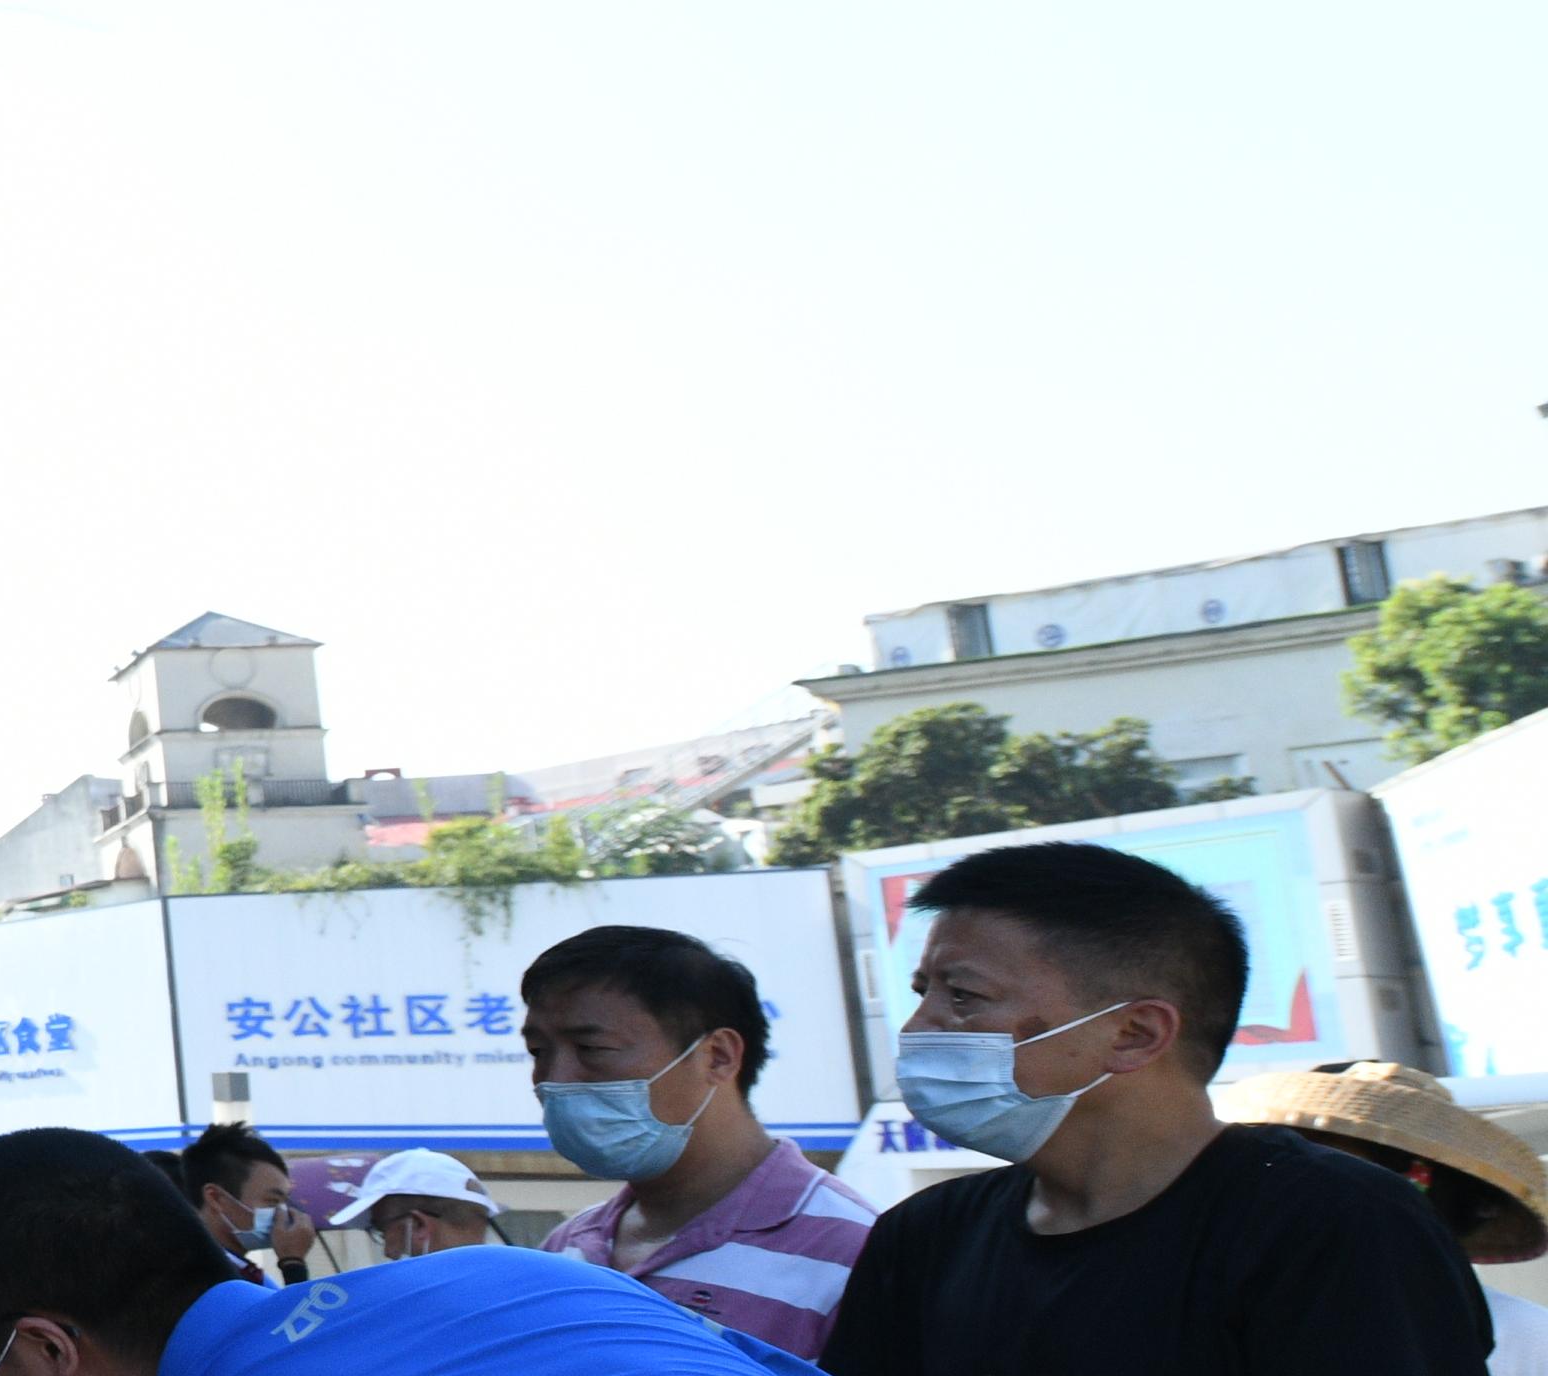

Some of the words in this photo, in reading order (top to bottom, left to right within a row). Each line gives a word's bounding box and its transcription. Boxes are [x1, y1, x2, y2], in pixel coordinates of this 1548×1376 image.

[235, 1051, 325, 1070] Angong
[331, 1050, 467, 1068] community
[270, 1280, 350, 1344] ZTO
